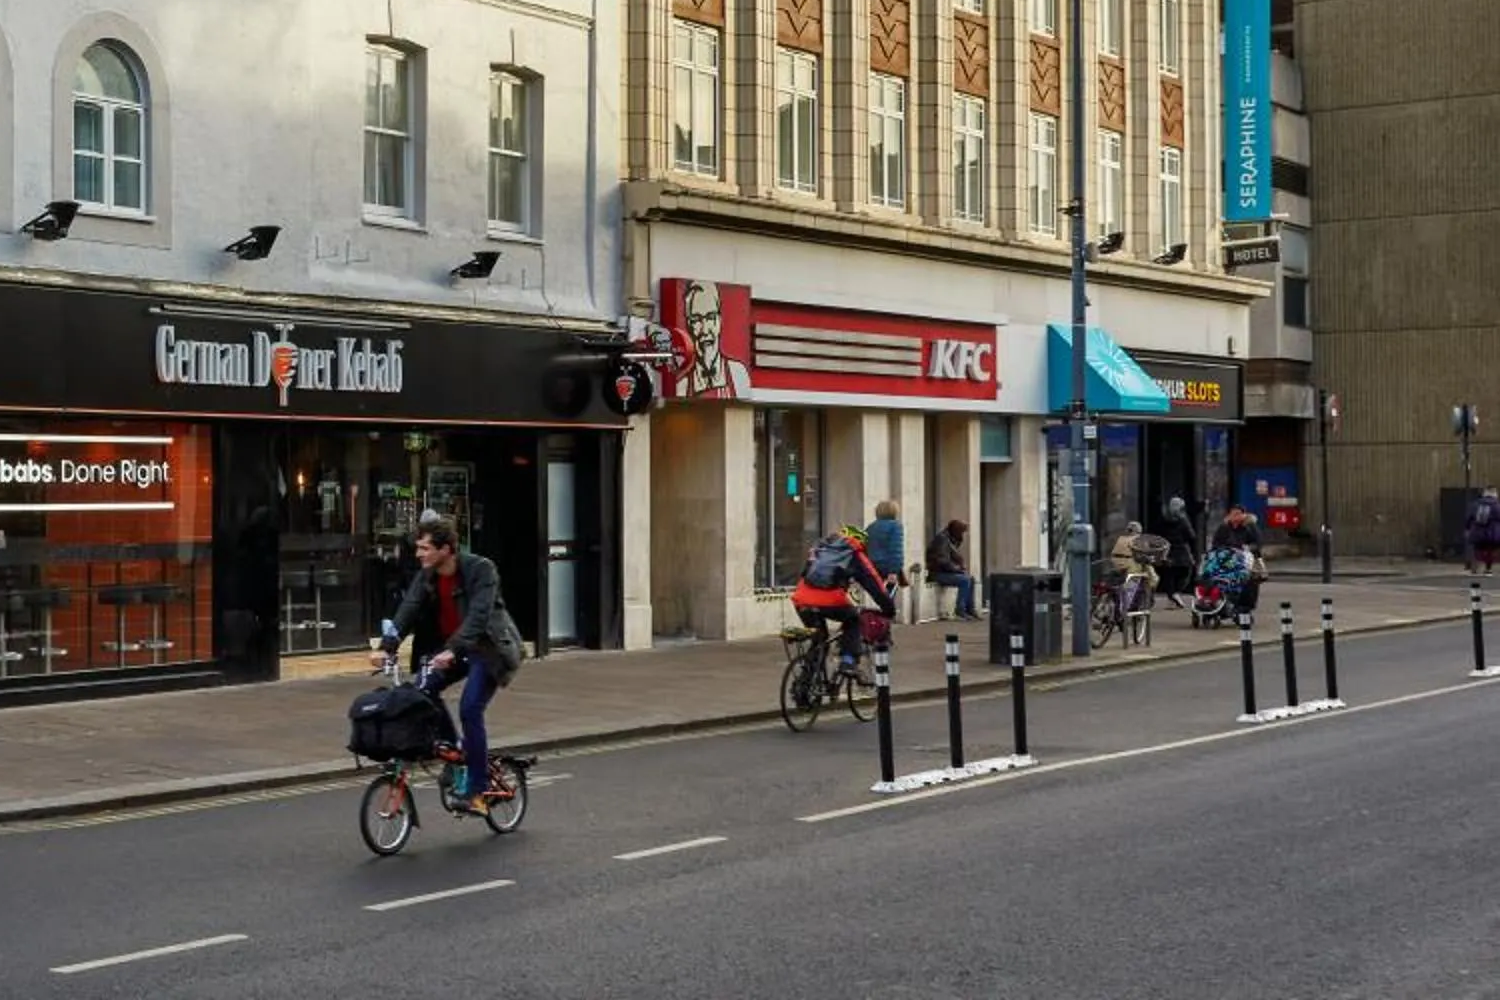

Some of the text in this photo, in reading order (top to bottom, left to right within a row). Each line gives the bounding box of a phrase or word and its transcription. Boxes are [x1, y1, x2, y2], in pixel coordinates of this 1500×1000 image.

[1240, 97, 1257, 207] SERAPHINE
[1234, 247, 1272, 261] HOTEL
[155, 324, 251, 387] German
[336, 336, 404, 393] Kebab
[928, 339, 991, 382] KFC
[1187, 381, 1221, 402] SLOTS
[61, 459, 116, 483] Done
